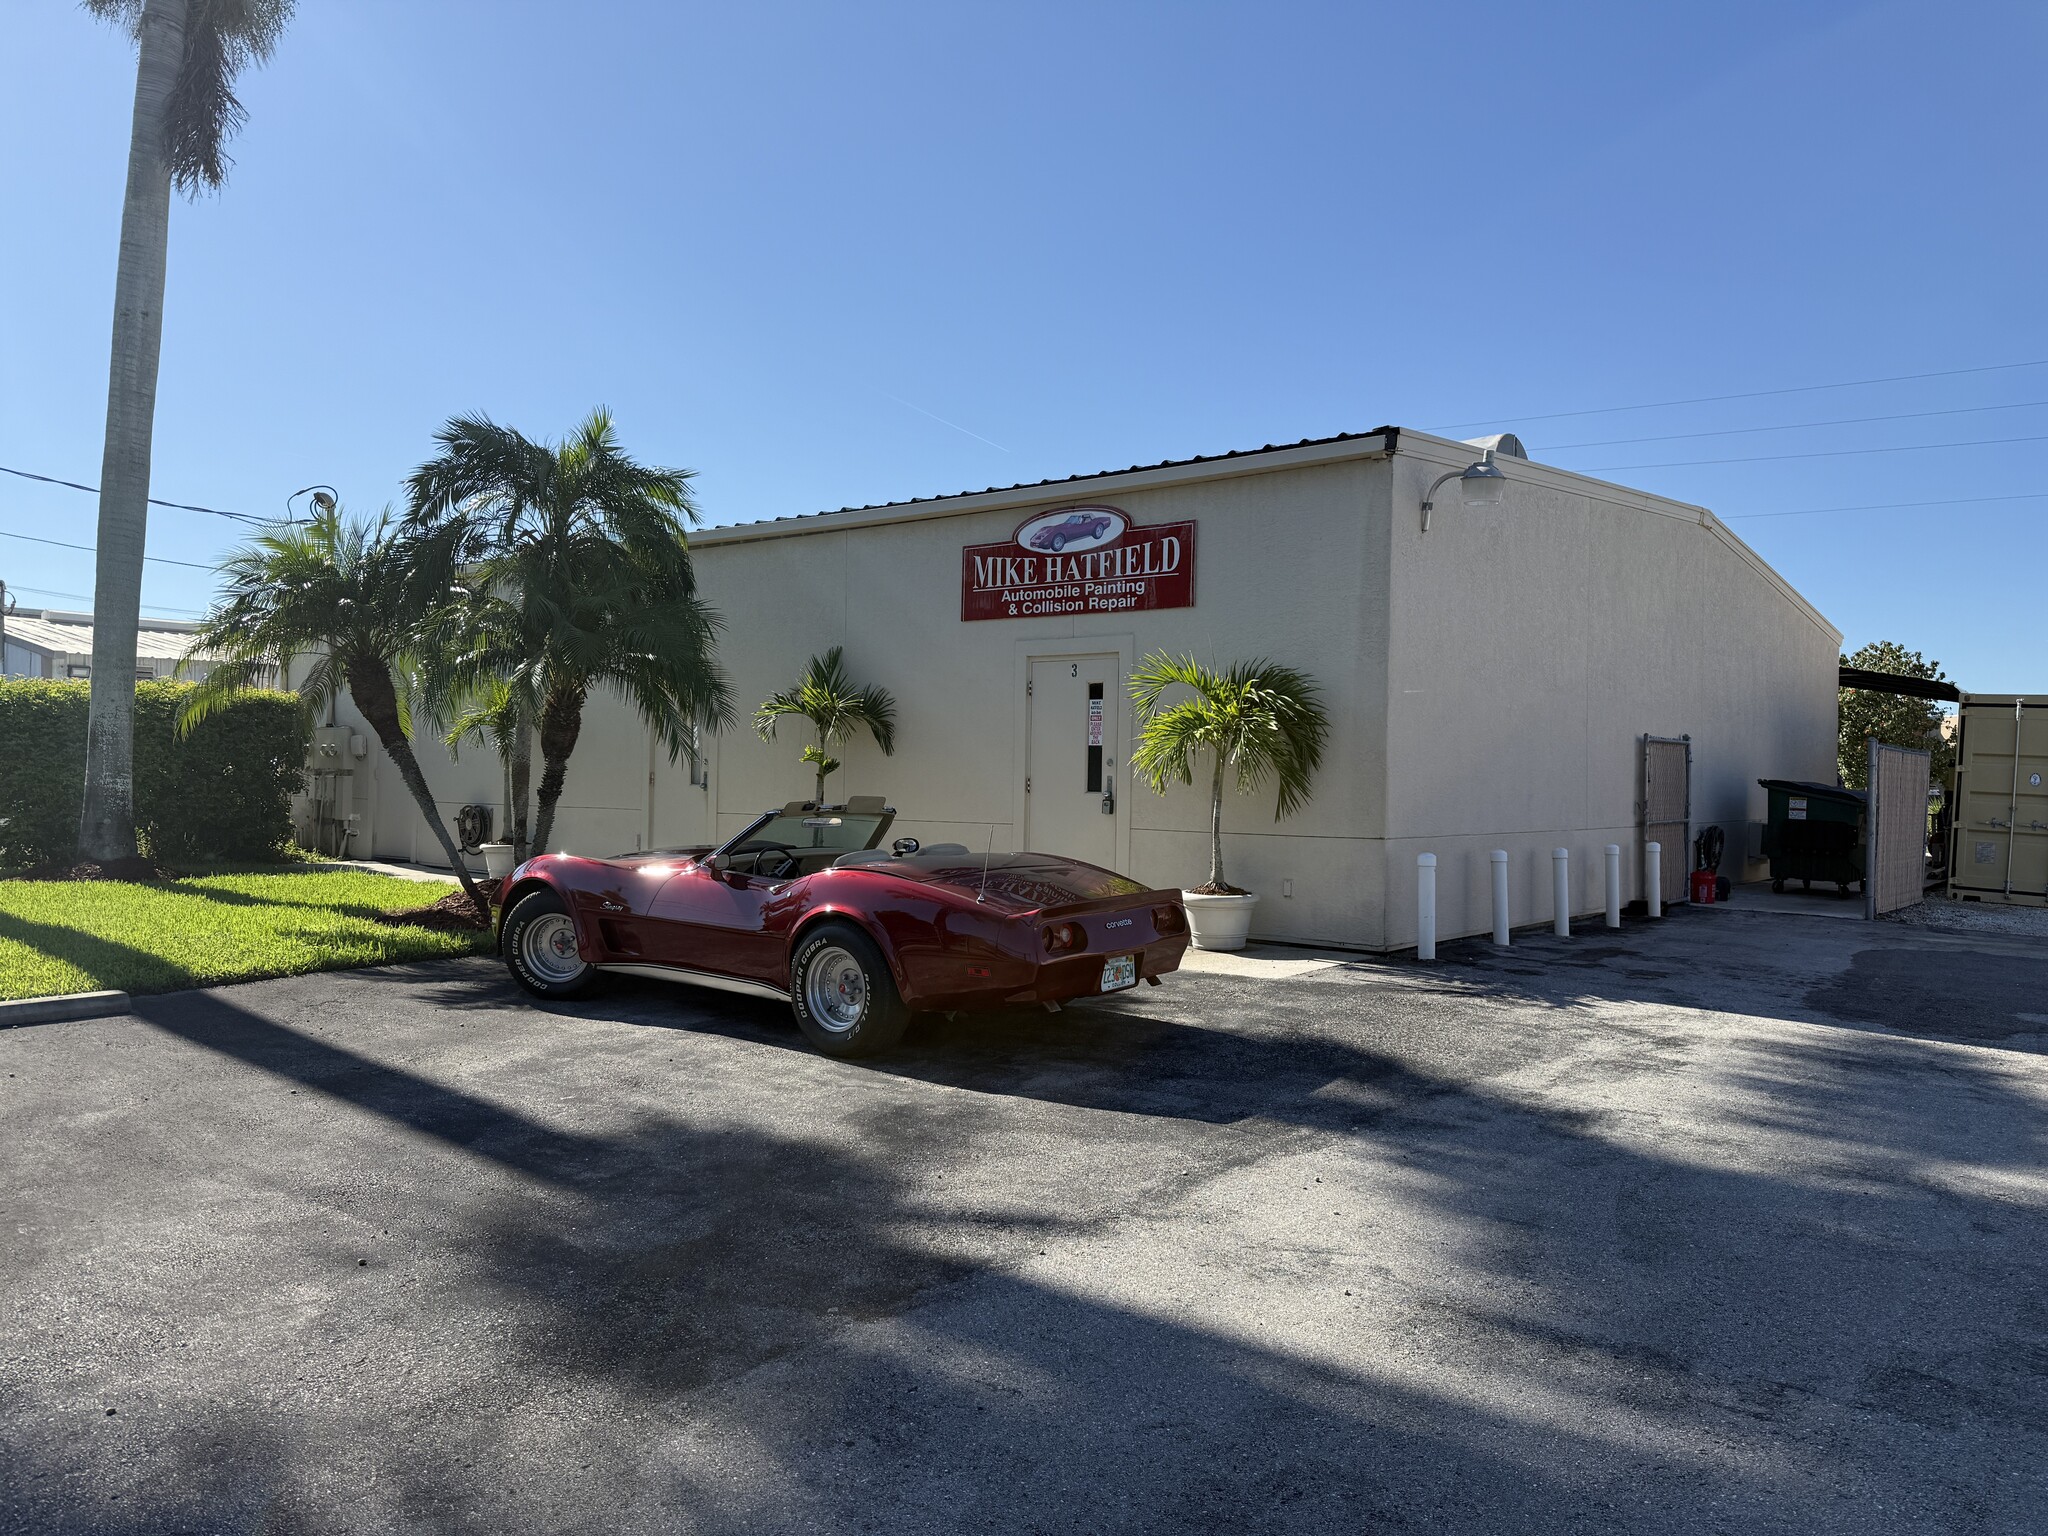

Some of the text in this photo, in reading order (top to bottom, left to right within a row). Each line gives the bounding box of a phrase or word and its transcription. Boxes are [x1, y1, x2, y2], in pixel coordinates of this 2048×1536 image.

[973, 536, 1181, 589] MIKE HATFIELD
[1001, 581, 1145, 602] Automobile Painting
[1008, 595, 1138, 615] & Collision Repair
[1071, 664, 1078, 677] 3
[1106, 918, 1133, 929] corvette
[512, 920, 549, 990] COOPER COBRA
[795, 937, 828, 1019] COOPER COBRA
